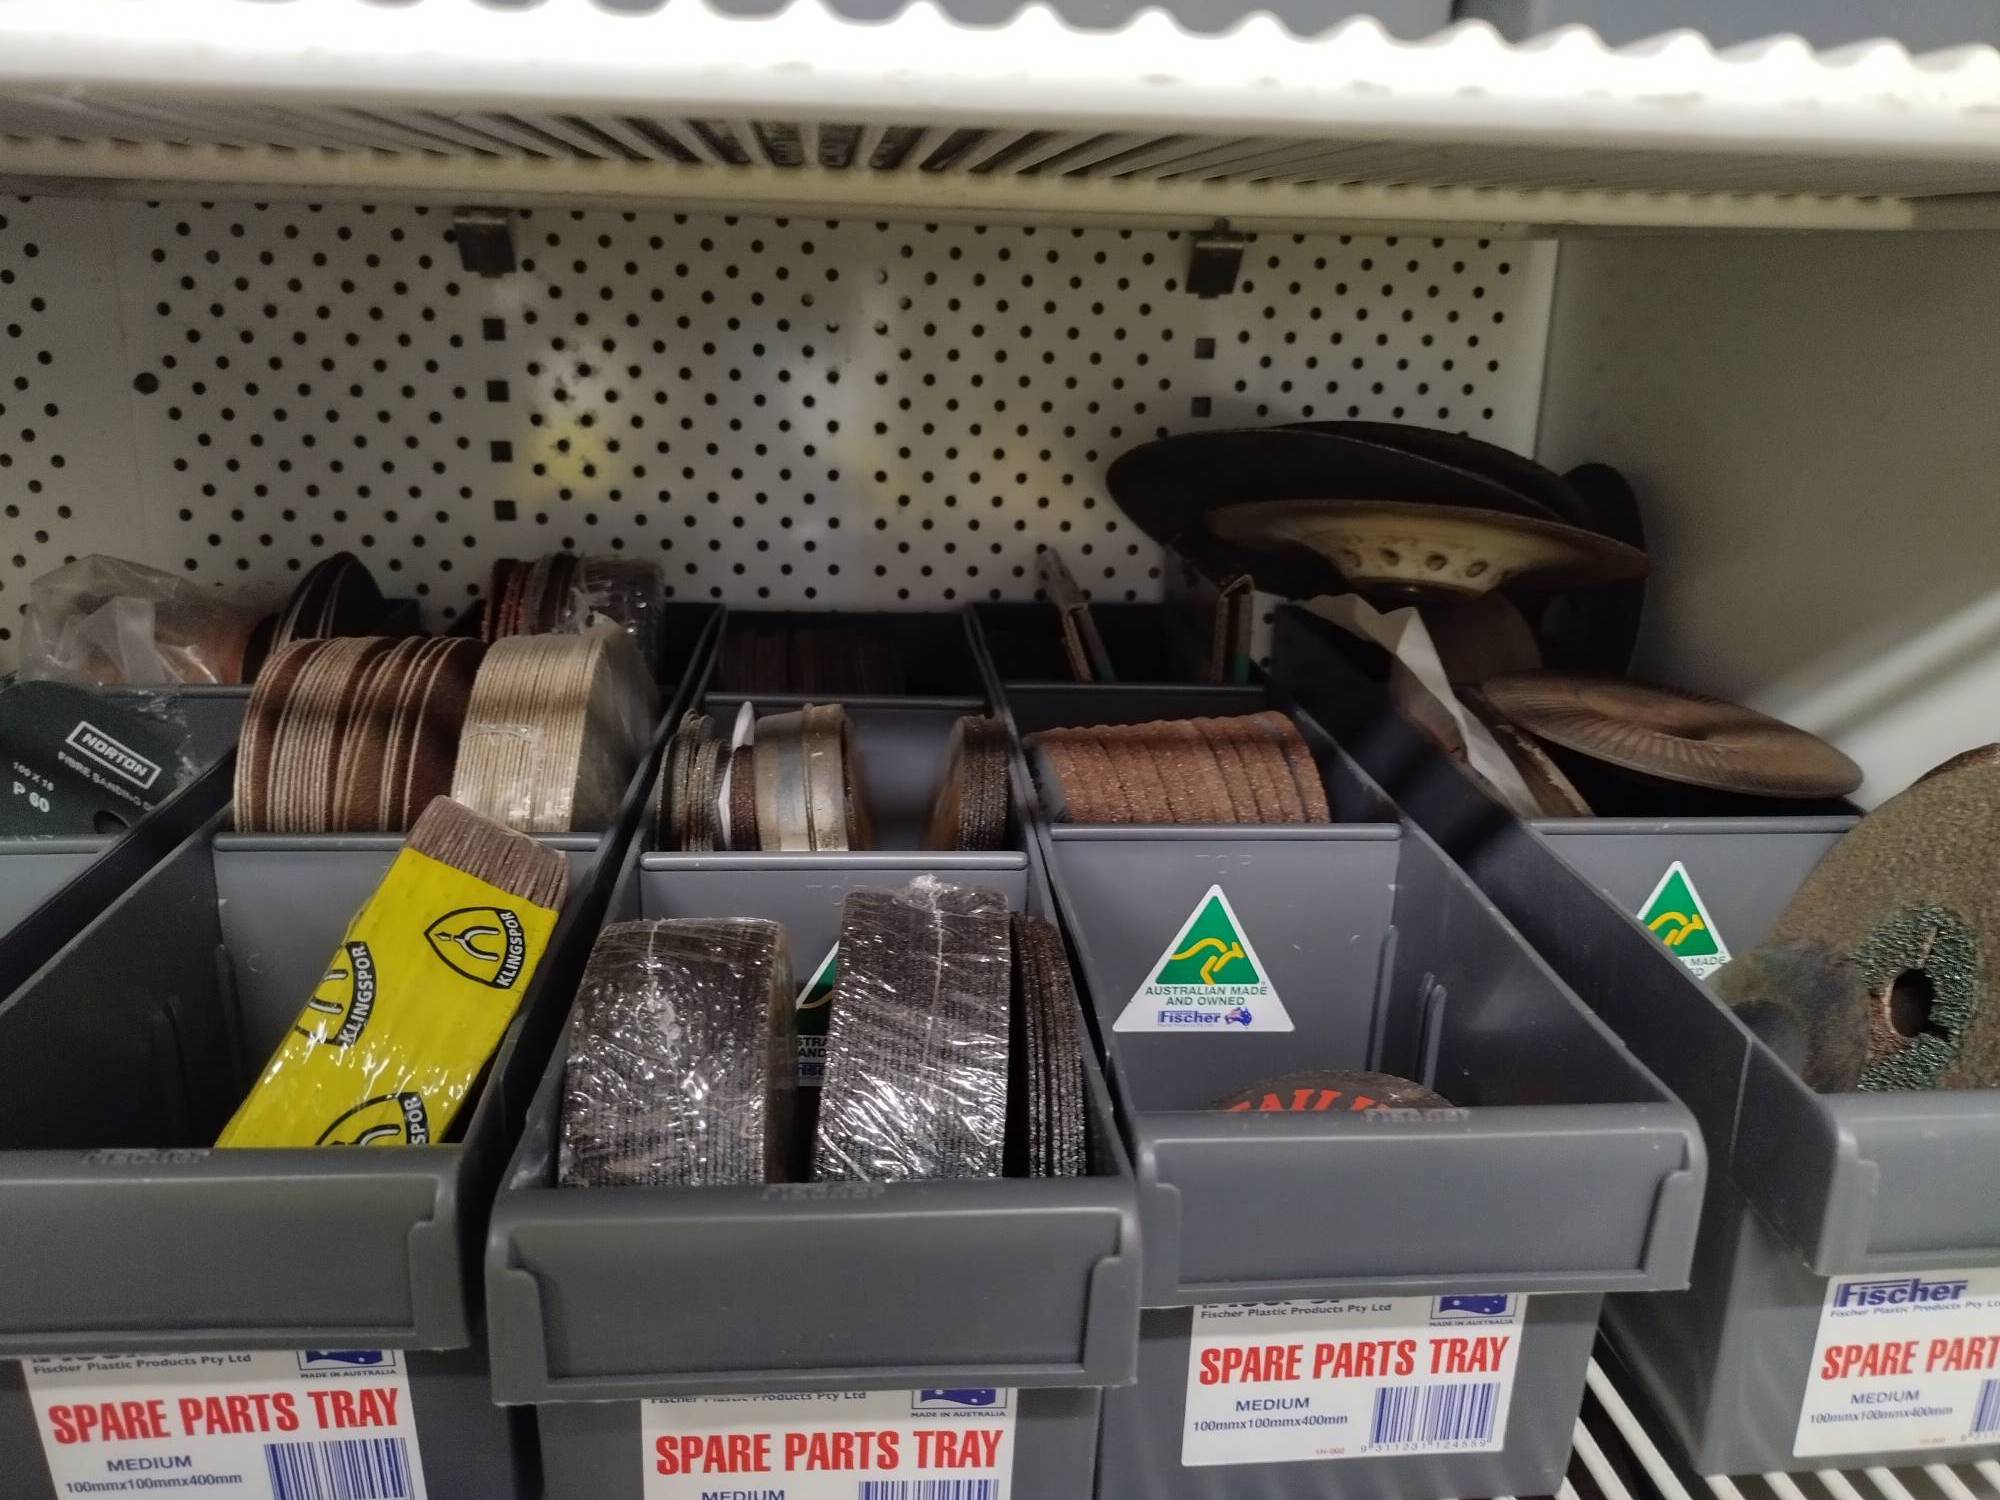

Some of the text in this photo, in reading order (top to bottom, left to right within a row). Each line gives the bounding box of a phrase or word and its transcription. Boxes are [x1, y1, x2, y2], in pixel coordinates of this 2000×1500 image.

[83, 732, 149, 777] NORTON
[13, 782, 26, 795] P
[497, 911, 524, 988] KLINGSPOR
[340, 946, 374, 1044] KLINGSPOR
[1145, 987, 1268, 996] AUSTRALIAN MADE
[1166, 997, 1246, 1006] AND OWNED
[1158, 1010, 1221, 1025] Fischer
[1833, 1278, 1969, 1308] Fischer
[1200, 1307, 1245, 1319] Fischer
[1248, 1306, 1289, 1317] Plastic
[1291, 1304, 1344, 1315] Products
[1347, 1303, 1369, 1314] Pty
[1371, 1302, 1393, 1312] Ltd
[33, 1354, 252, 1374] Fischer Plastic Products Pty Ltd
[1200, 1336, 1510, 1386] SPARE PARTS TRAY
[1821, 1335, 2000, 1381] SPARE PART
[844, 1391, 867, 1400] Ltd
[1235, 1397, 1310, 1412] MEDIUM
[1850, 1390, 1920, 1405] MEDIUM
[48, 1388, 399, 1445] SPARE PARTS TRAY
[1193, 1415, 1348, 1432] 100mmx100mmx400mm
[655, 1429, 1004, 1475] SPARE PARTS TRAY
[106, 1455, 192, 1472] MEDIUM
[66, 1473, 243, 1494] 100mmx100mmx400mm
